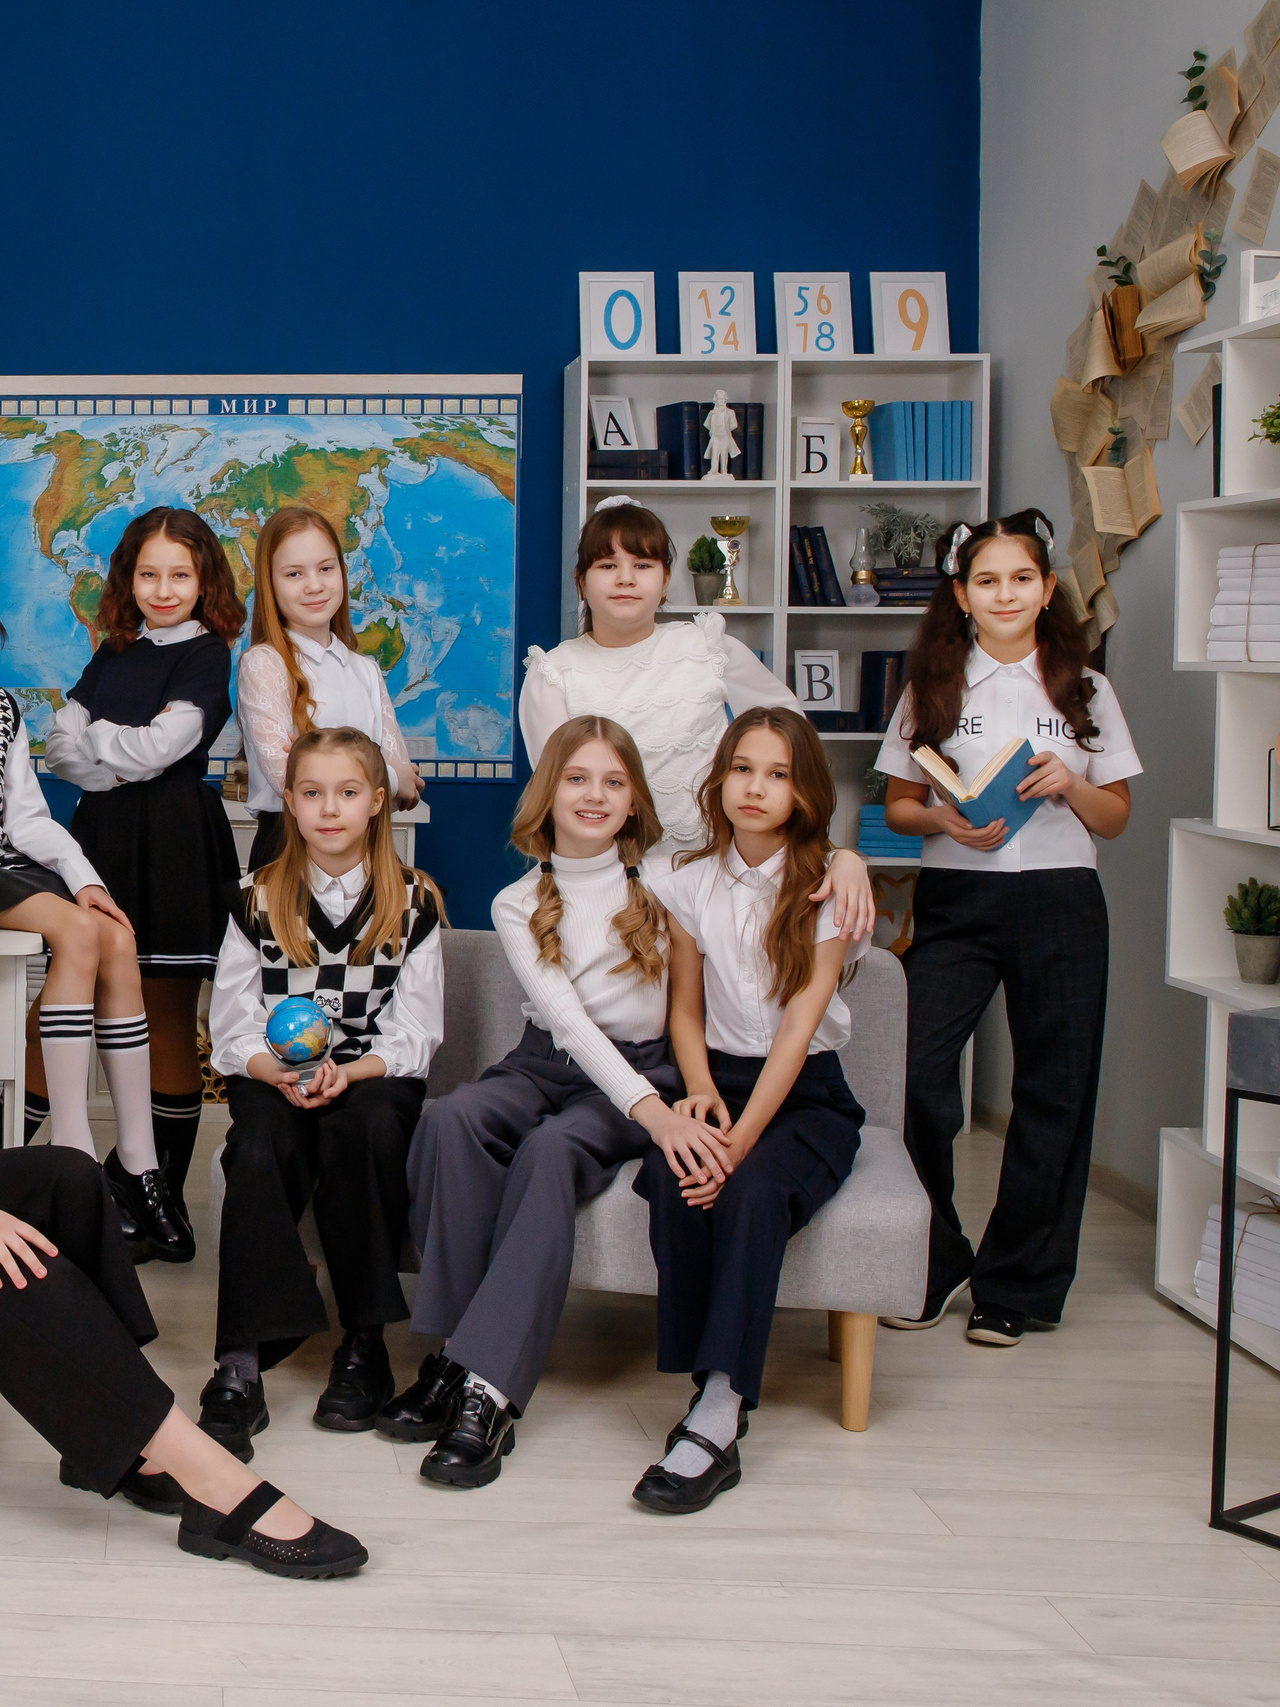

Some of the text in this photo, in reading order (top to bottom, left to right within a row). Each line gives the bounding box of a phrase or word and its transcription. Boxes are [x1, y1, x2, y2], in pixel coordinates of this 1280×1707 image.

[898, 288, 930, 351] 9
[220, 399, 277, 414] МИР
[603, 411, 632, 446] А
[801, 434, 828, 474] Б
[801, 663, 834, 702] В
[1036, 717, 1091, 744] HIG
